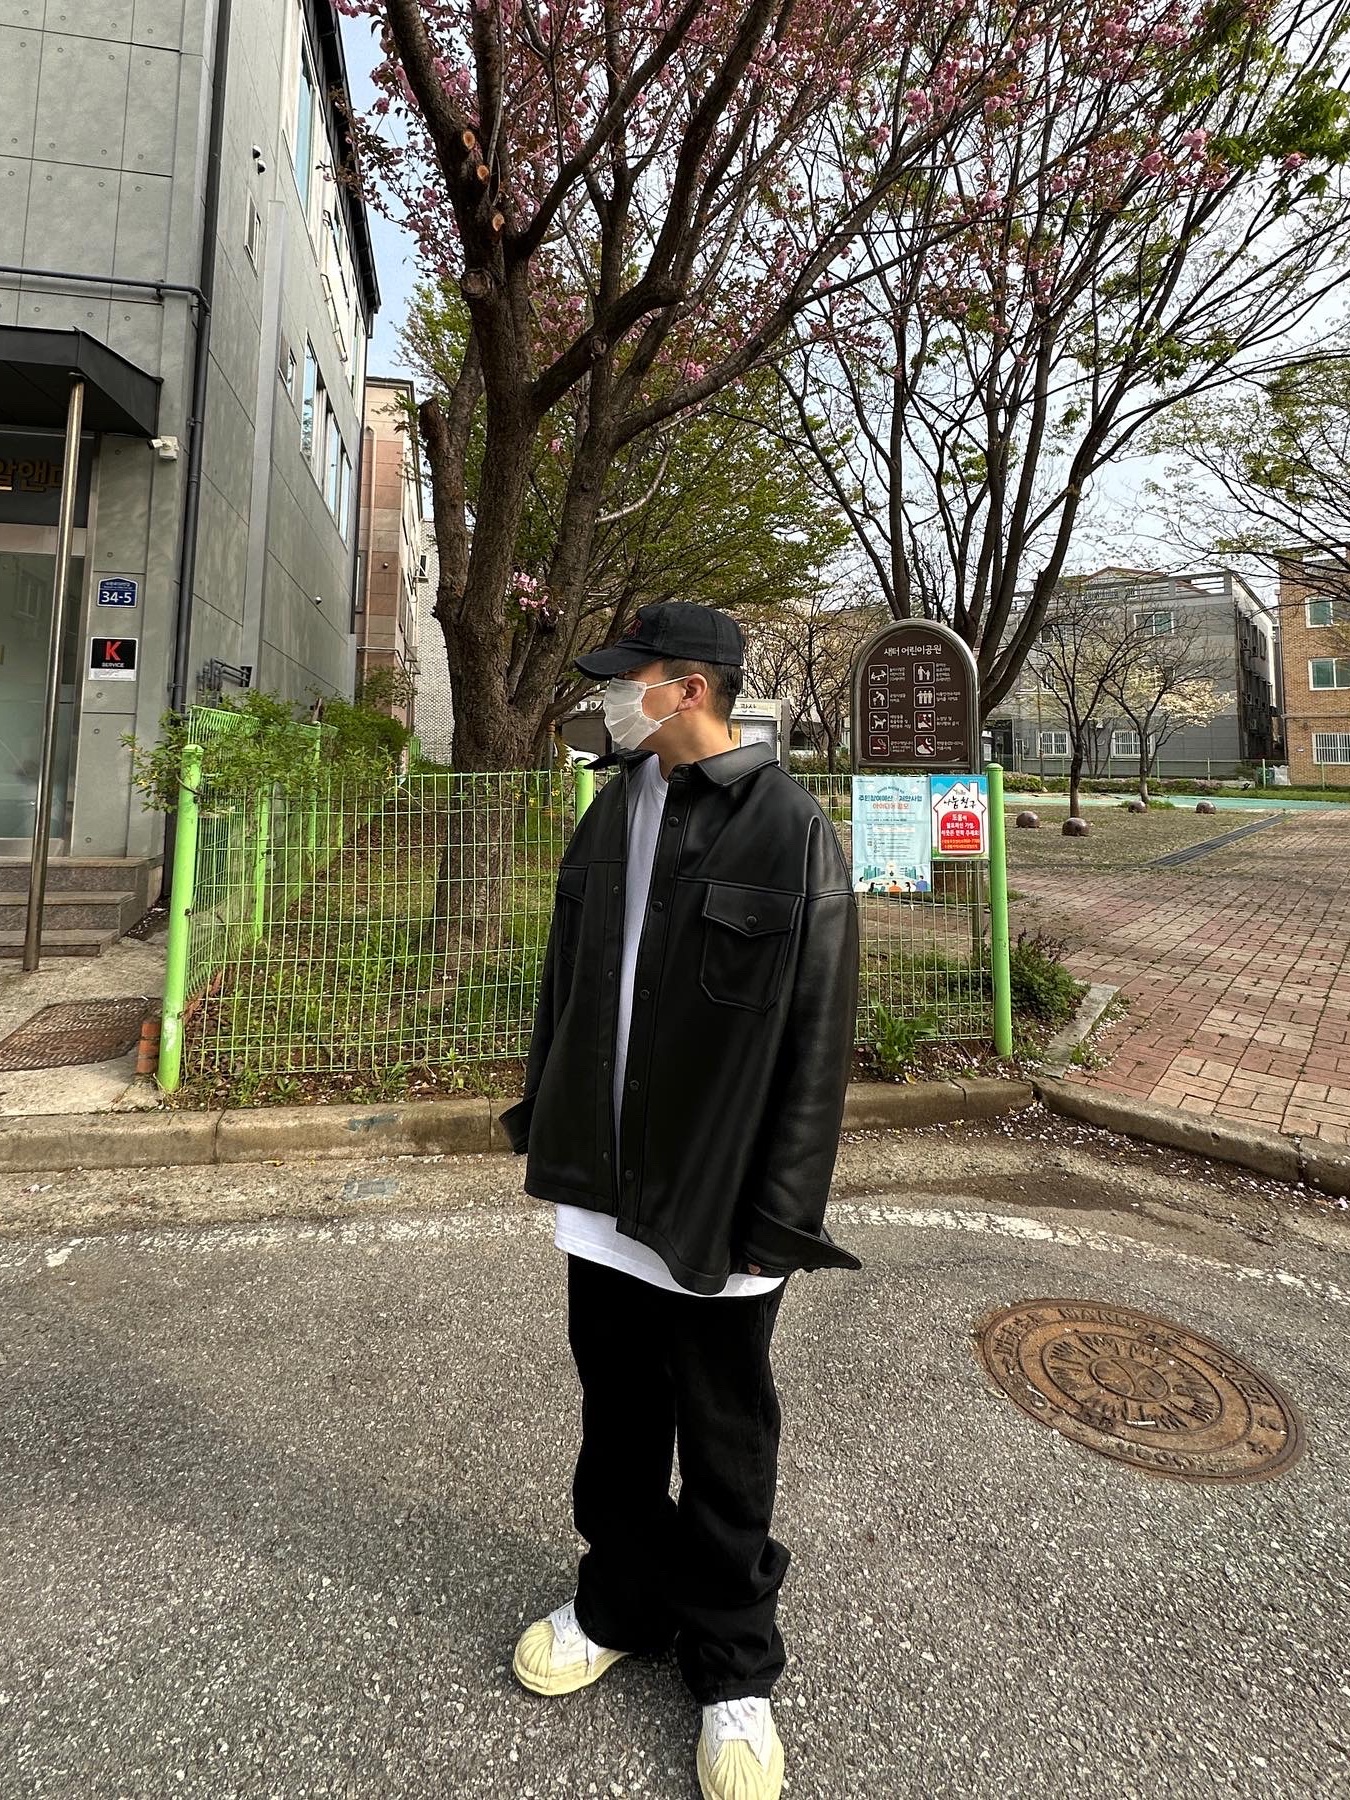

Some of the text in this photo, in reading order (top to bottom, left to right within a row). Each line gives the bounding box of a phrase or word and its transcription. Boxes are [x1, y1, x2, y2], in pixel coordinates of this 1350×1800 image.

[101, 591, 132, 604] 34-5
[105, 641, 122, 661] K
[884, 644, 942, 656] 새터 어린이공원
